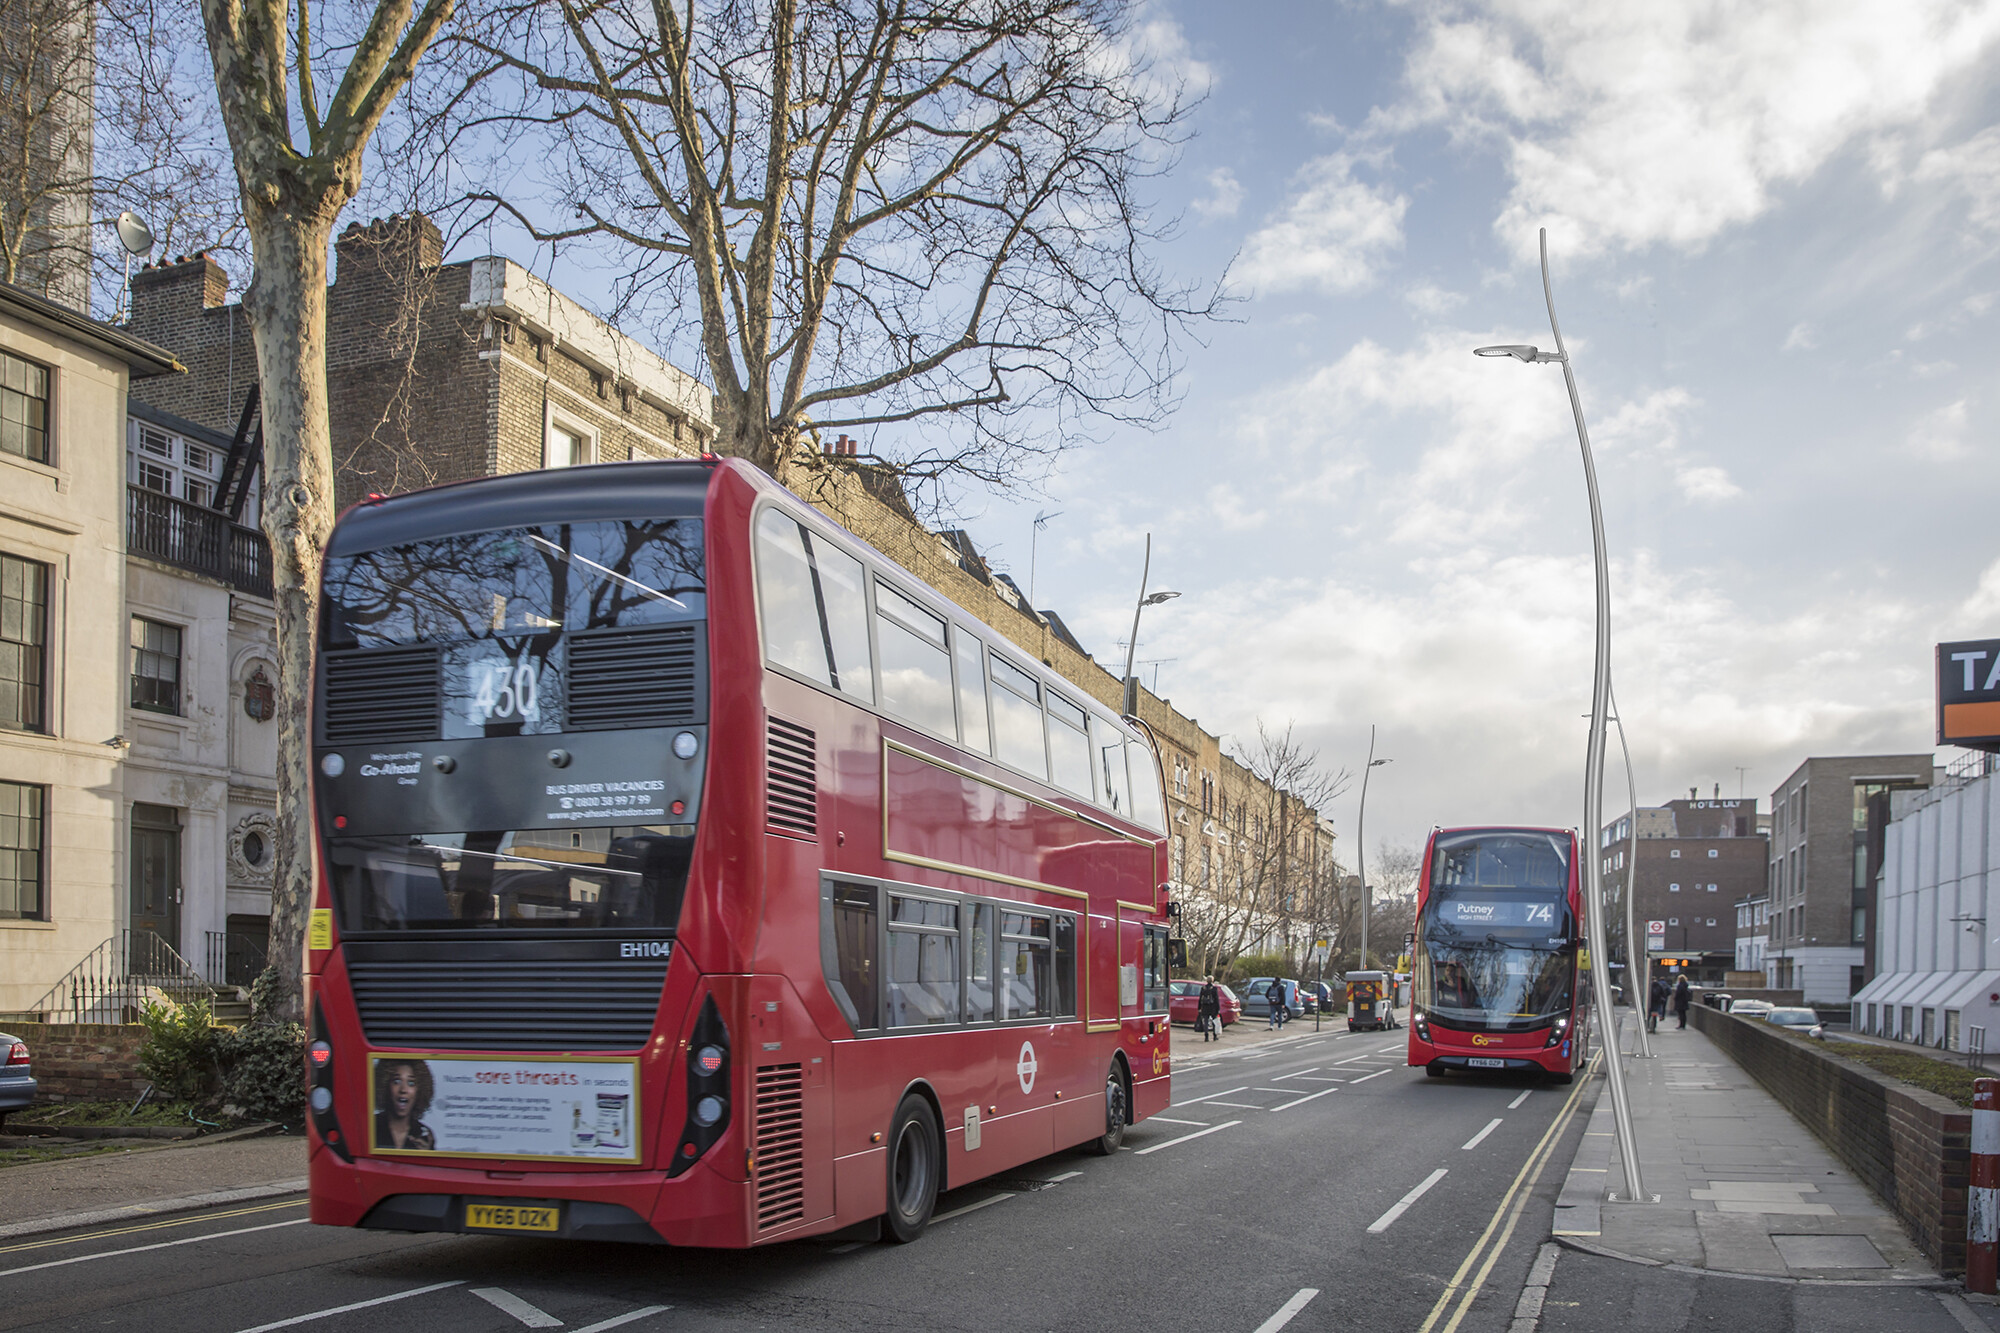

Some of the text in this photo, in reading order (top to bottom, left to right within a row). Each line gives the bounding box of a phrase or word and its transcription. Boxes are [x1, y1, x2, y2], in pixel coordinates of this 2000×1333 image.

[472, 663, 537, 718] 430
[360, 761, 421, 776] Go-Ahead
[546, 780, 665, 795] BUS DRIVER VACANCIES
[1457, 903, 1552, 922] Putney 74
[620, 942, 670, 957] EH104
[475, 1071, 512, 1085] sore
[515, 1069, 579, 1086] throats
[594, 1078, 630, 1087] seconds
[473, 1207, 552, 1227] YY66 OZK
